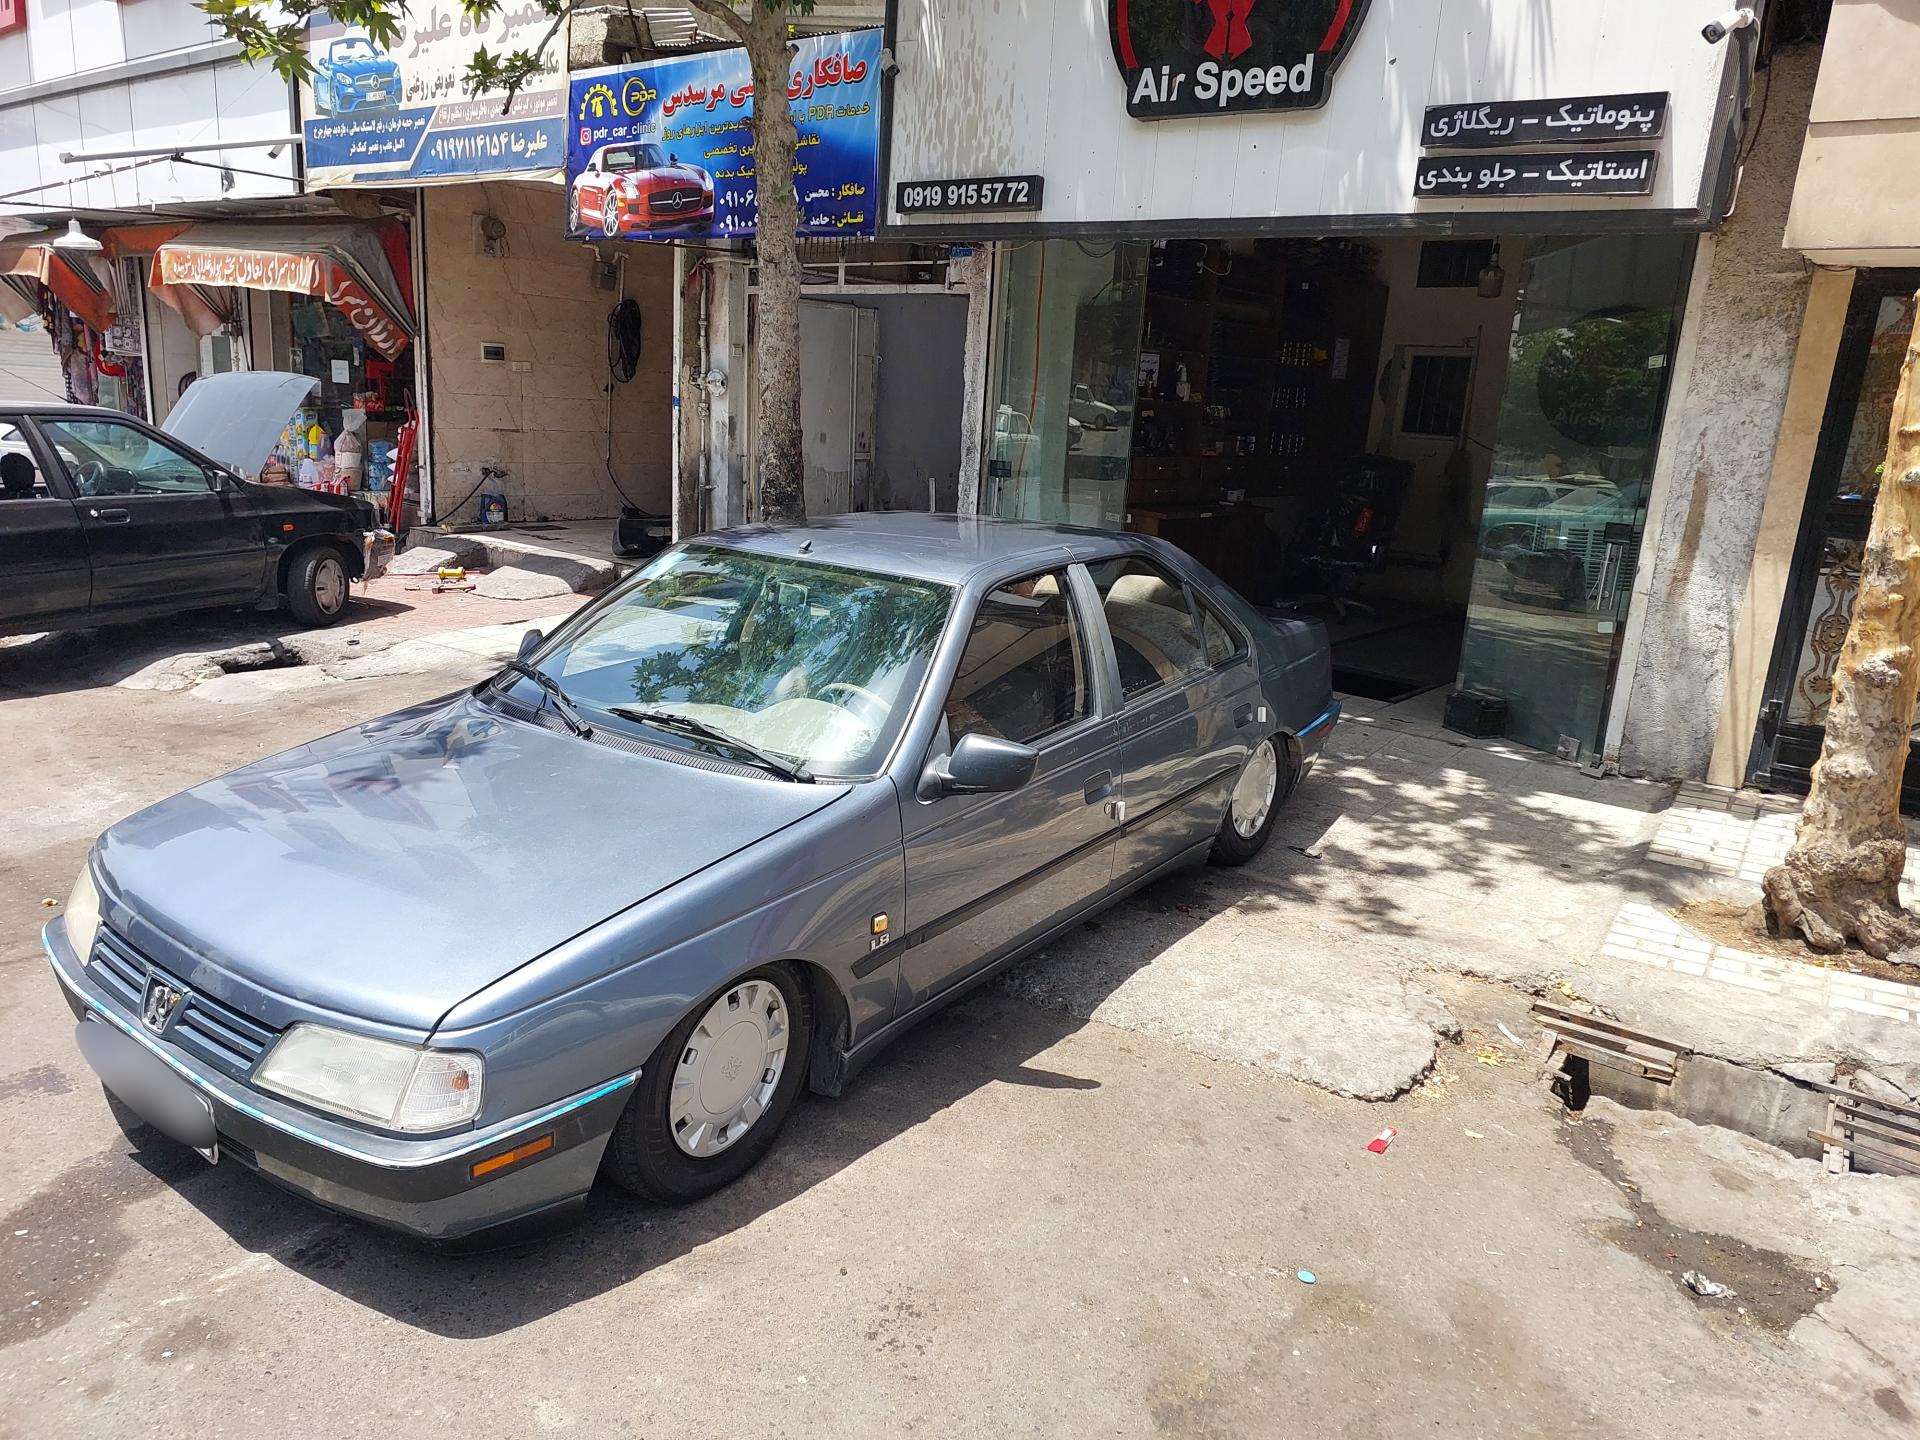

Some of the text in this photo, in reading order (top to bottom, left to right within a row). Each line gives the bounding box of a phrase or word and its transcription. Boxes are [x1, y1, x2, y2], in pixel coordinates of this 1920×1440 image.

[787, 52, 867, 101] صافکاری
[1131, 53, 1315, 107] Air Speed
[631, 88, 657, 103] PDR
[662, 83, 726, 117] مرسدس
[808, 104, 835, 122] PDR
[835, 101, 871, 118] خدمات
[1430, 105, 1514, 136] ریگلاژی
[1545, 102, 1655, 133] پنوماتیک
[593, 121, 657, 142] pdr_car_clinic
[661, 126, 676, 141] روز
[430, 129, 548, 160] علیرضا ۰۹۱۹۷۱۱۴۱۵۴
[703, 142, 738, 159] تخصصی
[715, 168, 735, 180] بدنه
[1419, 165, 1473, 190] بندی
[1477, 163, 1516, 188] جلو
[1546, 159, 1648, 187] استاتیک
[804, 188, 830, 202] محسن
[836, 182, 865, 201] صافکار
[903, 186, 942, 207] 0919
[947, 185, 977, 206] 915
[809, 213, 830, 226] حامد
[263, 252, 289, 287] سرای
[287, 254, 320, 289] ارزان
